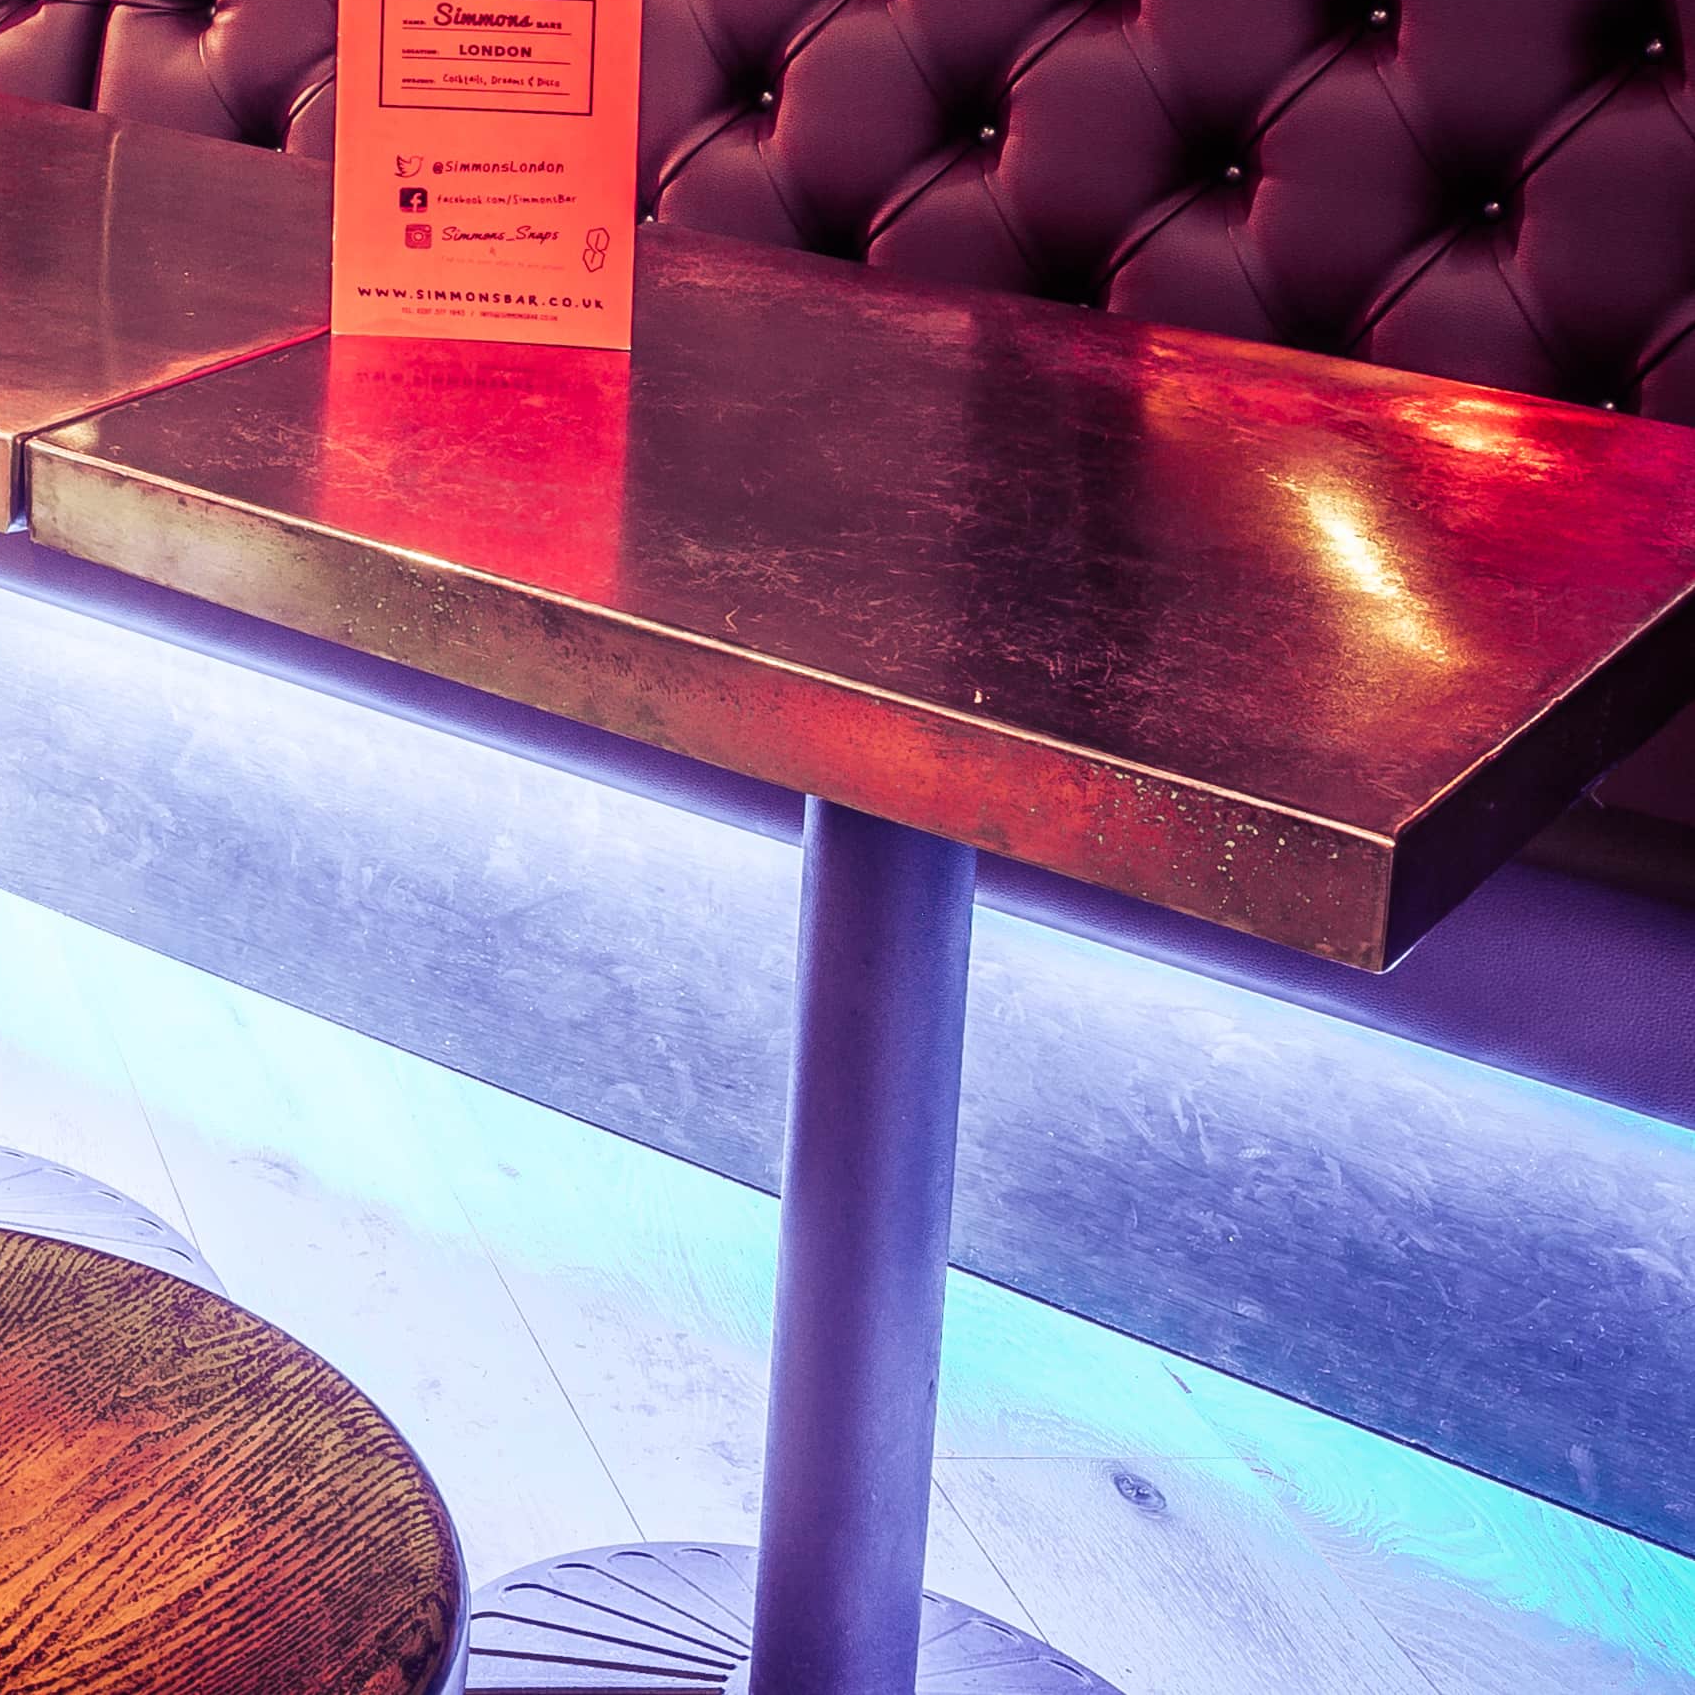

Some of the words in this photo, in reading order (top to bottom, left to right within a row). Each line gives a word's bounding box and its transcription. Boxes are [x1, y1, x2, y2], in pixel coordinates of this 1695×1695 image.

[433, 2, 534, 29] Simmons
[458, 43, 533, 58] LONDON
[432, 160, 566, 175] @SimmonsLondon
[357, 286, 605, 310] WWW.SIMMONSBAR.CO.UK
